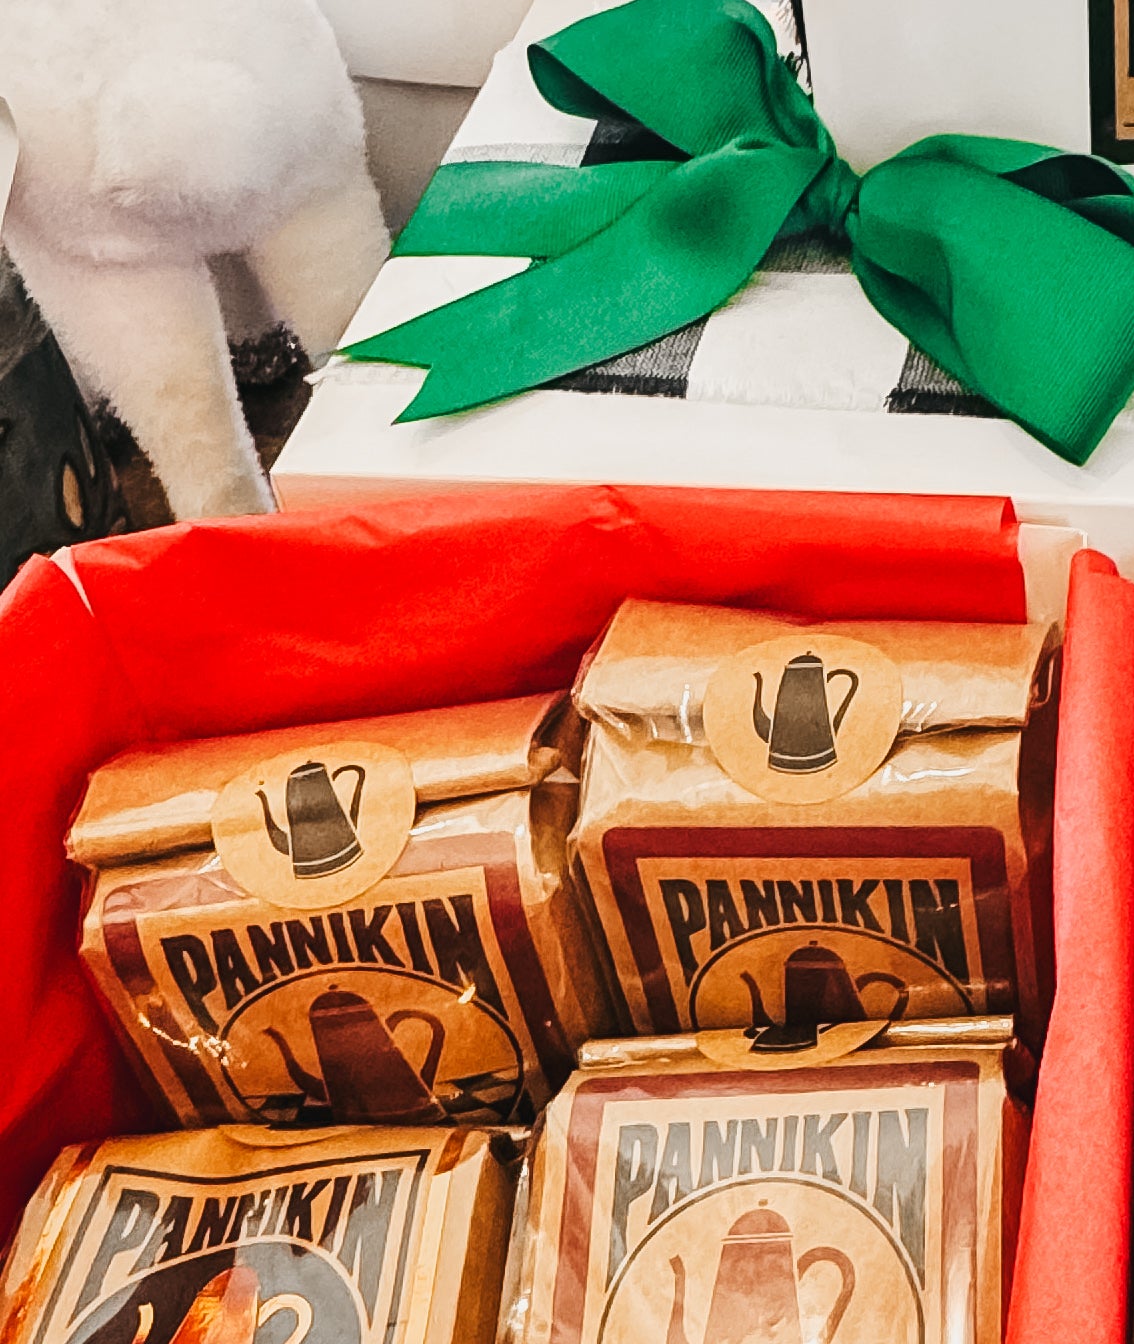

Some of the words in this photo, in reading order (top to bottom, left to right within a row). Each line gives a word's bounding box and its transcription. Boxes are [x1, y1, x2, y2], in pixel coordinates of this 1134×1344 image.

[160, 894, 509, 1031] PANNIKIN
[659, 878, 970, 989] PANNIKIN
[68, 1168, 404, 1329] PANNIKIN
[605, 1108, 930, 1294] PANNIKIN
